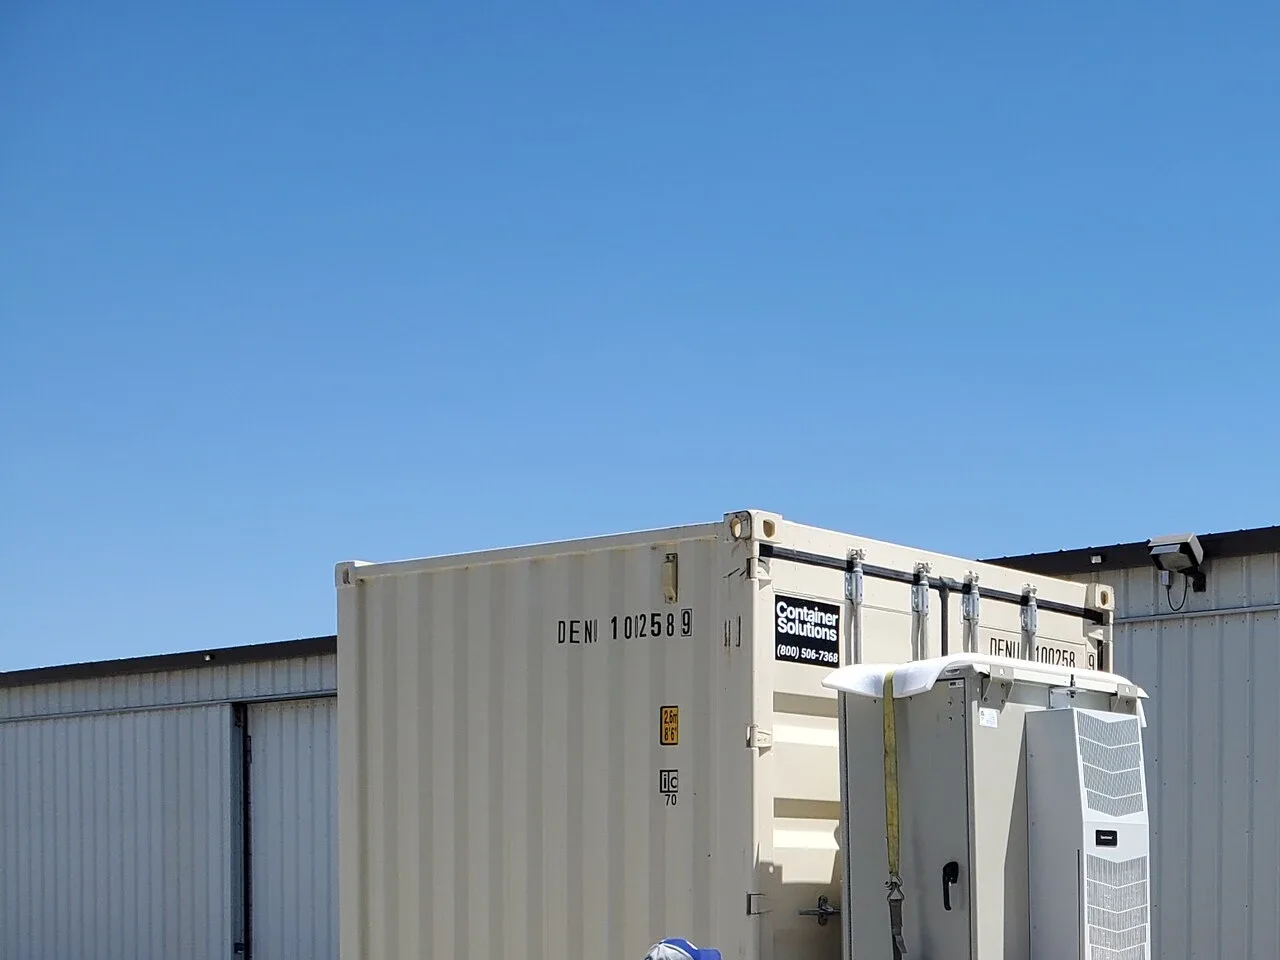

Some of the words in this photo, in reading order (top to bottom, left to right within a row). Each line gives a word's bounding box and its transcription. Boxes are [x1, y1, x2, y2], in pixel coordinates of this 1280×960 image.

[776, 601, 839, 626] Container
[777, 617, 838, 642] Solutions
[777, 643, 800, 660] (800)
[801, 647, 839, 664] 506-7368
[664, 793, 677, 806] 70
